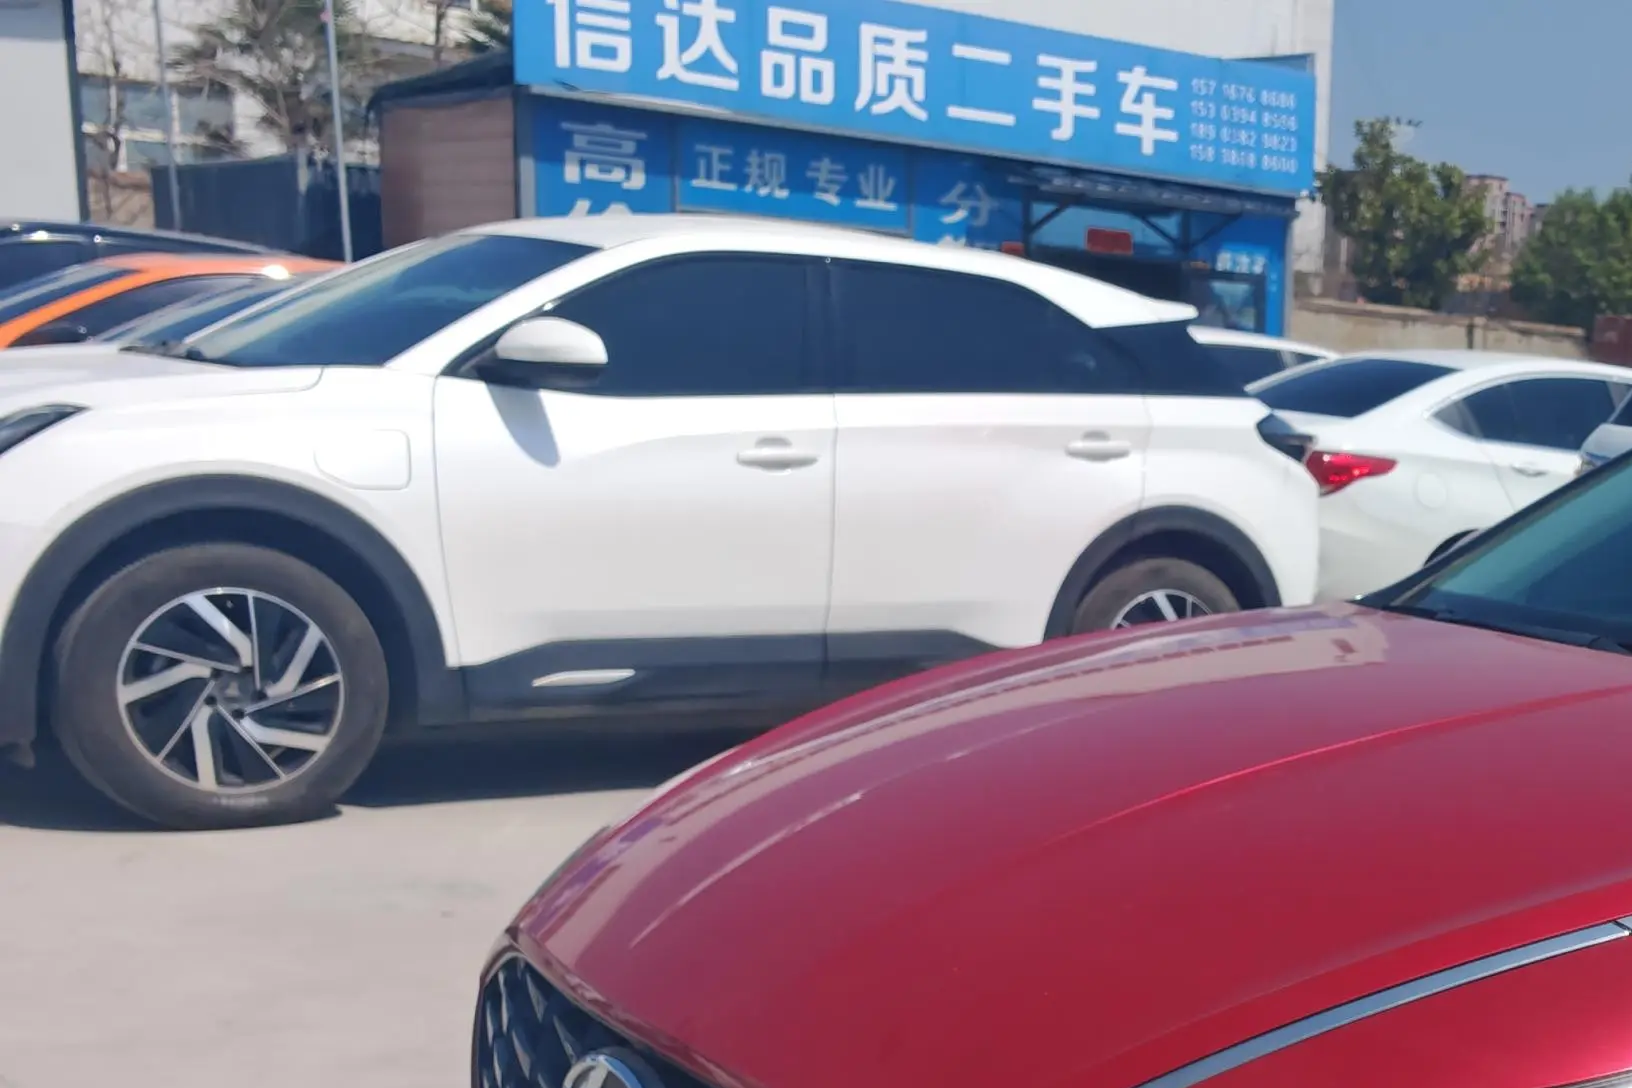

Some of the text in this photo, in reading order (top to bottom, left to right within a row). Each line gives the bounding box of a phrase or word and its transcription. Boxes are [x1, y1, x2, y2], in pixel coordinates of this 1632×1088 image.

[546, 0, 1179, 155] 信达品质二手车
[560, 122, 649, 218] 高
